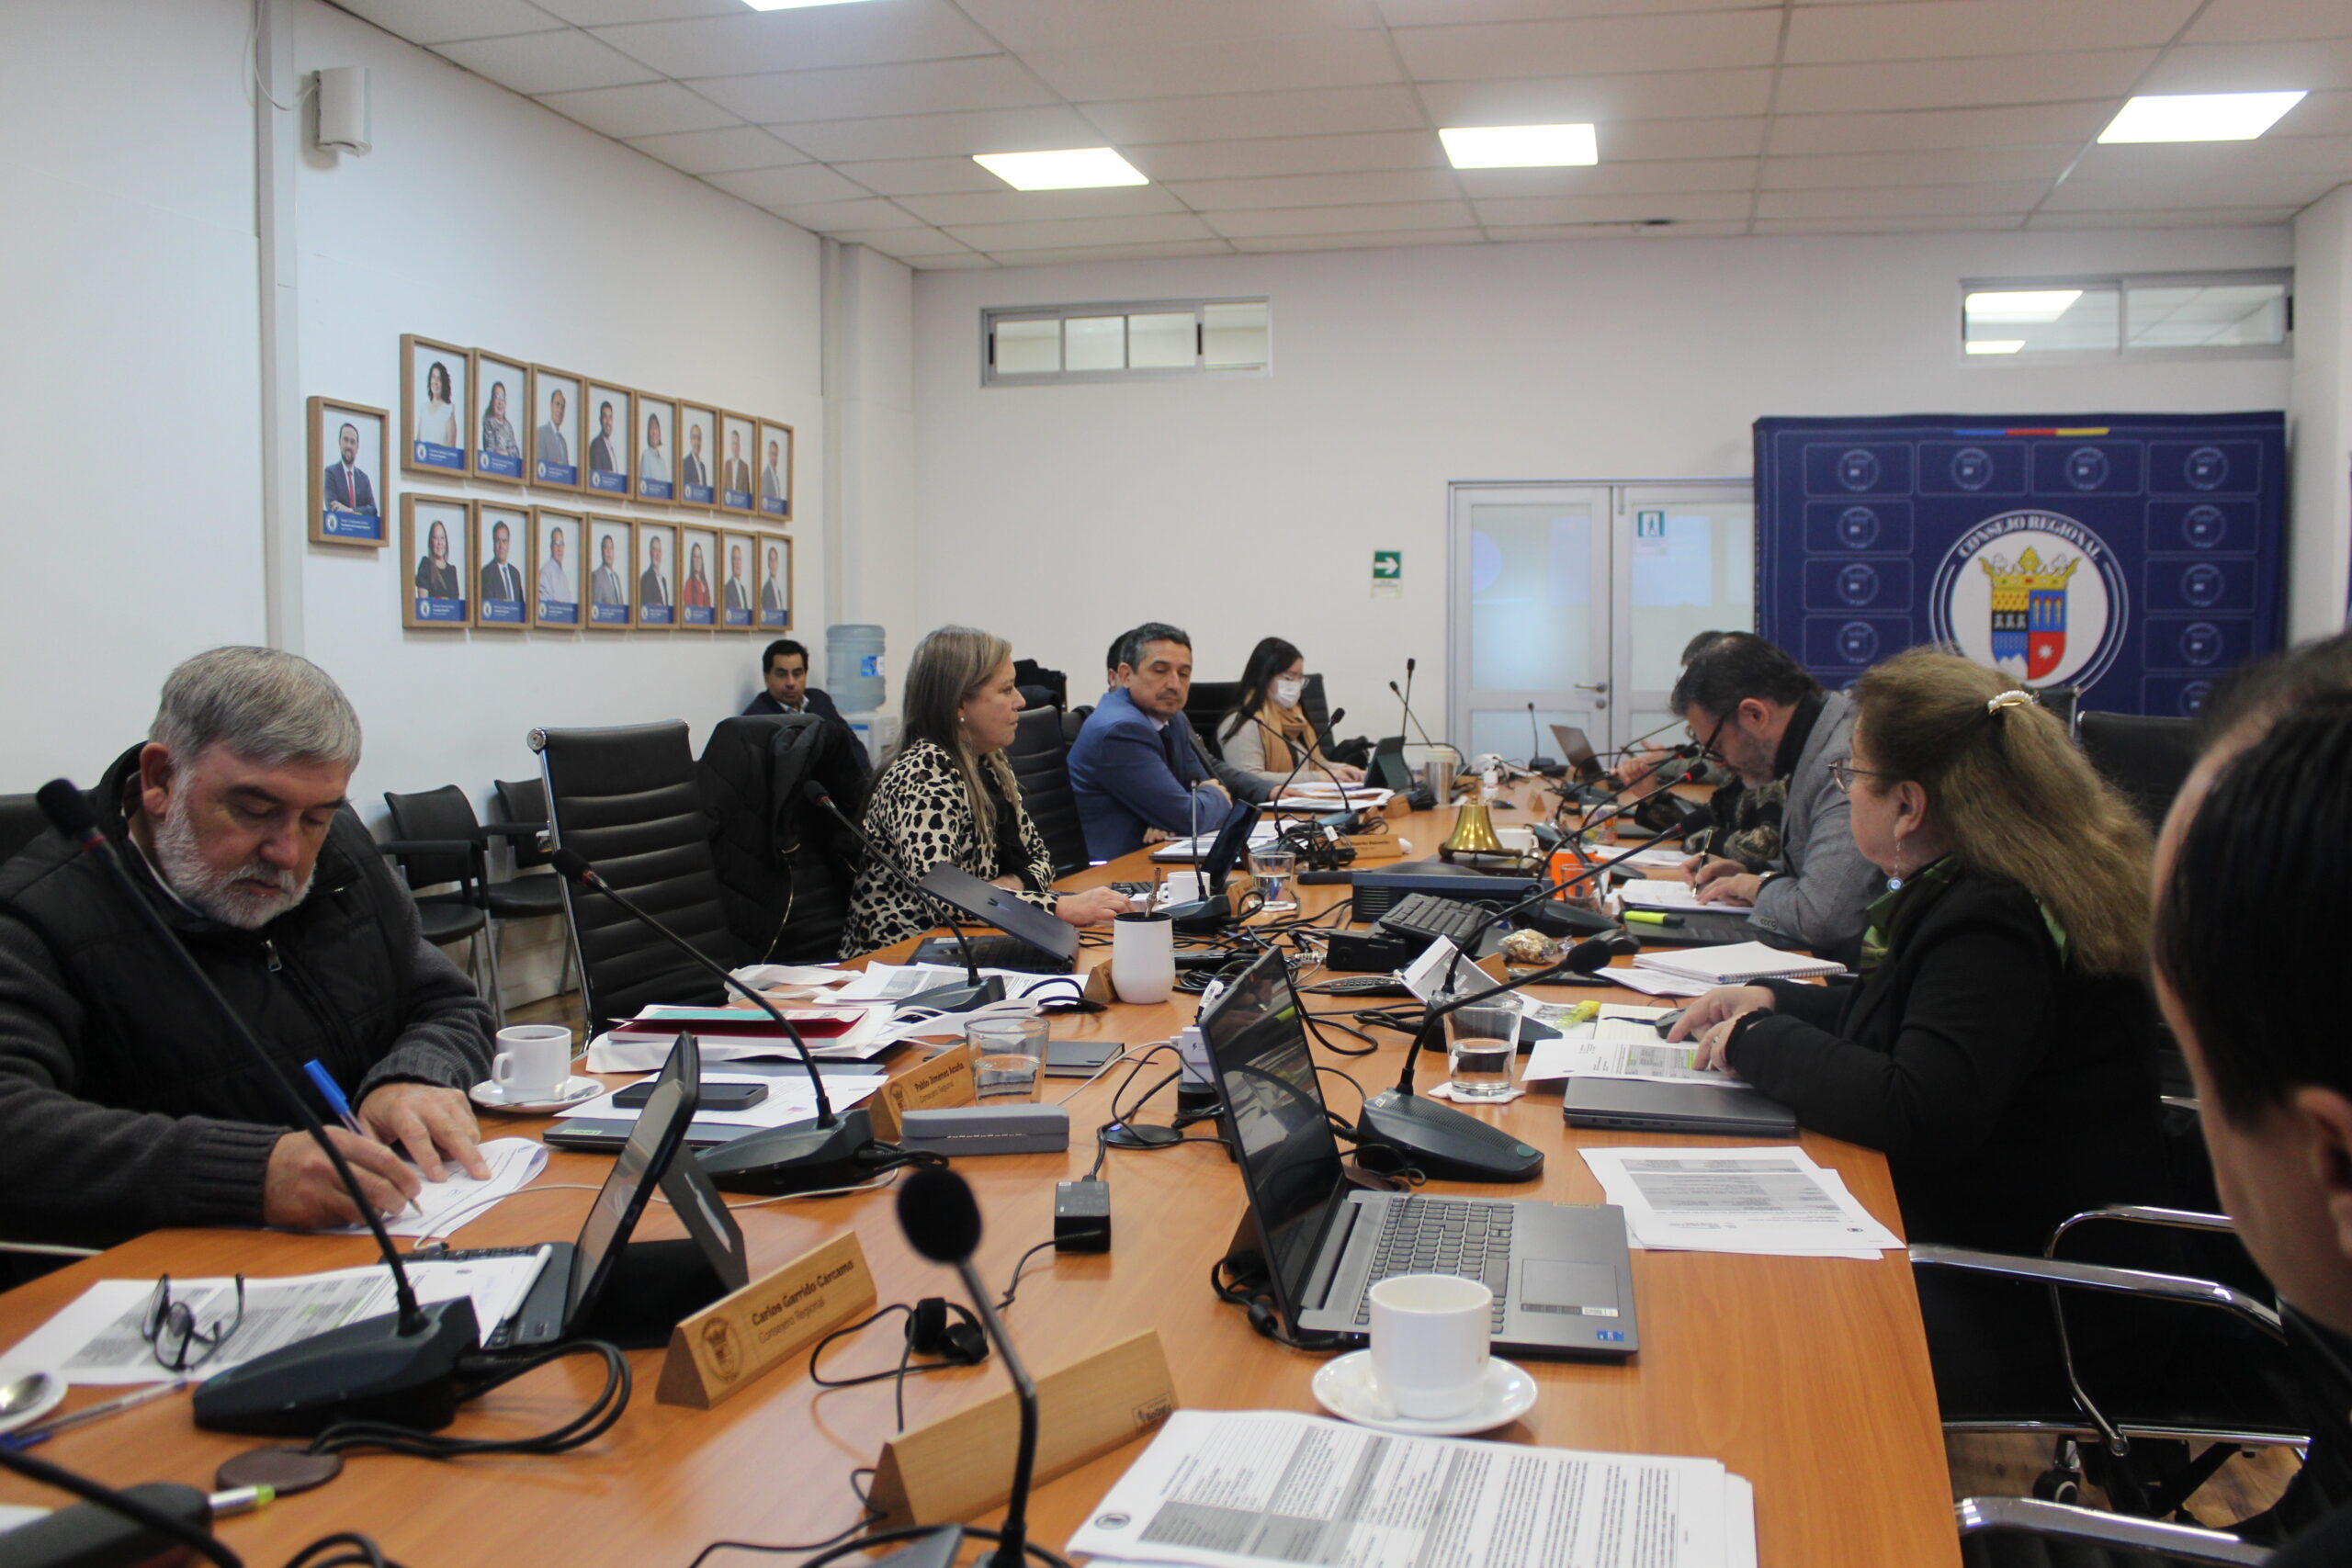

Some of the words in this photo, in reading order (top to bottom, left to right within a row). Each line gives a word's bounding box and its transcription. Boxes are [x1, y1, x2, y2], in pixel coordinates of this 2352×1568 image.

[1957, 514, 2027, 558] CONSEJO
[2027, 514, 2102, 560] REGIONAL
[914, 1079, 930, 1092] Pablo
[752, 1302, 783, 1325] Carlos
[782, 1282, 818, 1308] Garrido
[758, 1317, 795, 1344] Consejero
[794, 1295, 826, 1321] Regional
